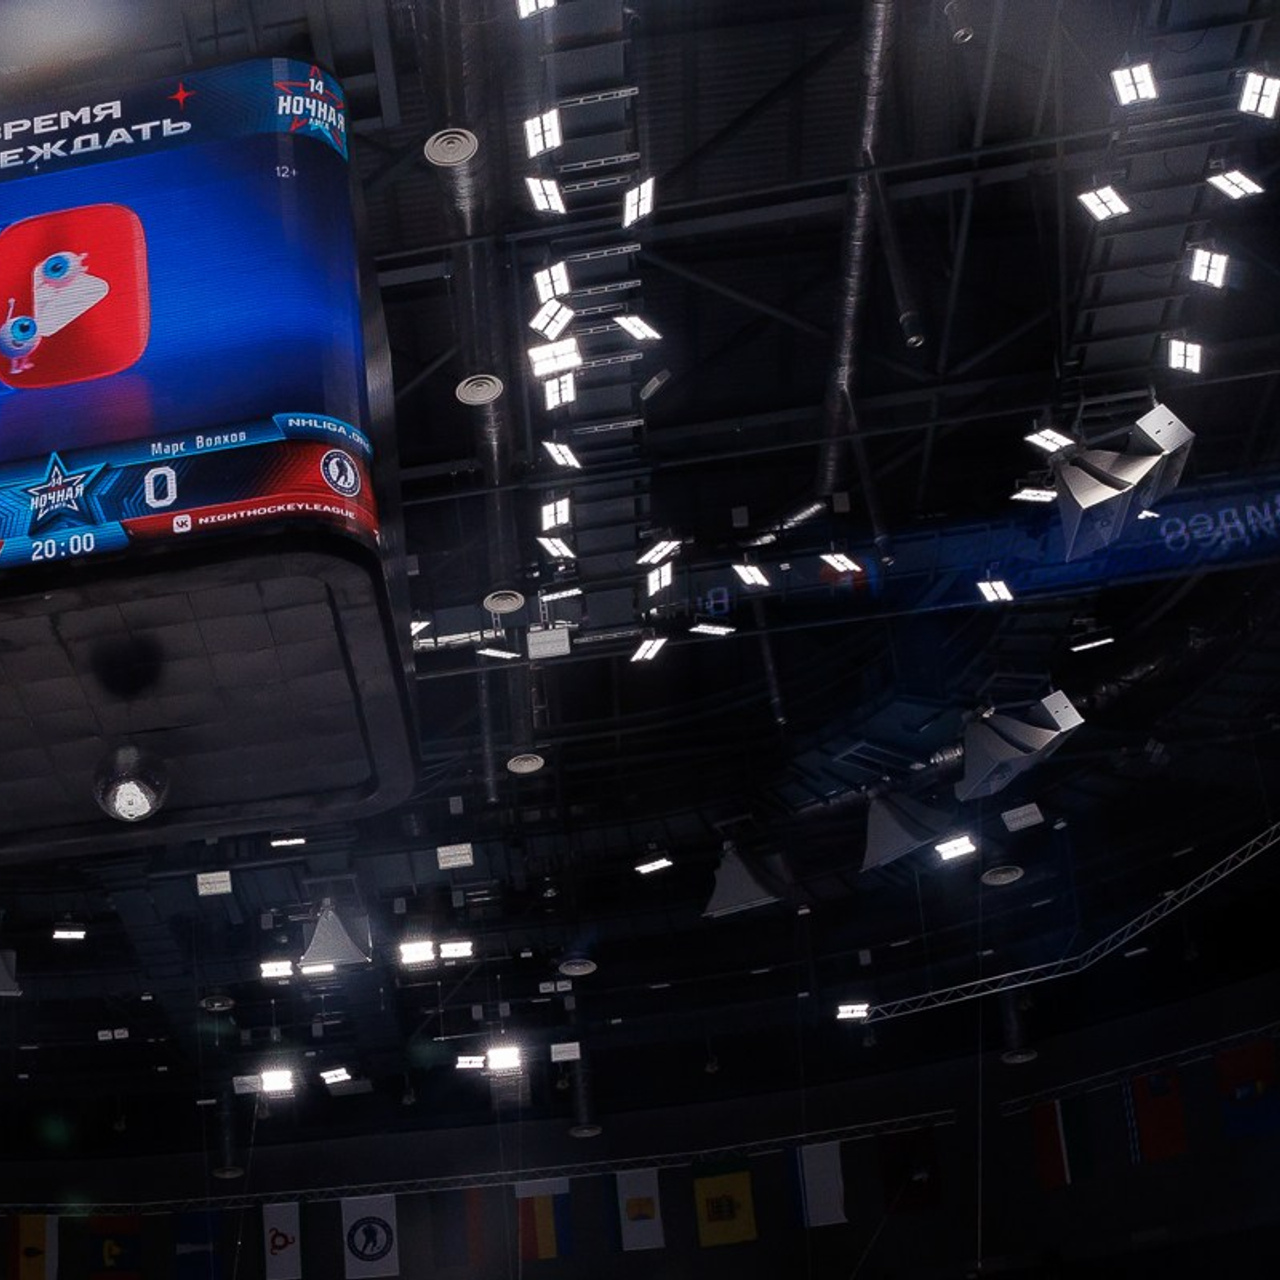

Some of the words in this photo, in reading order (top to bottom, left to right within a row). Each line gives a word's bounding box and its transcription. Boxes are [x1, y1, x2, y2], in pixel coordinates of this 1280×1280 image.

[309, 78, 324, 95] 14
[278, 94, 345, 133] НОЧНАЯ
[151, 441, 186, 456] Марс
[195, 431, 247, 450] Волхов
[30, 483, 85, 511] НОЧНАЯ
[144, 466, 178, 508] 0
[198, 502, 357, 525] NIGHTHOCKEYLEAGUE
[31, 532, 95, 562] 20:00
